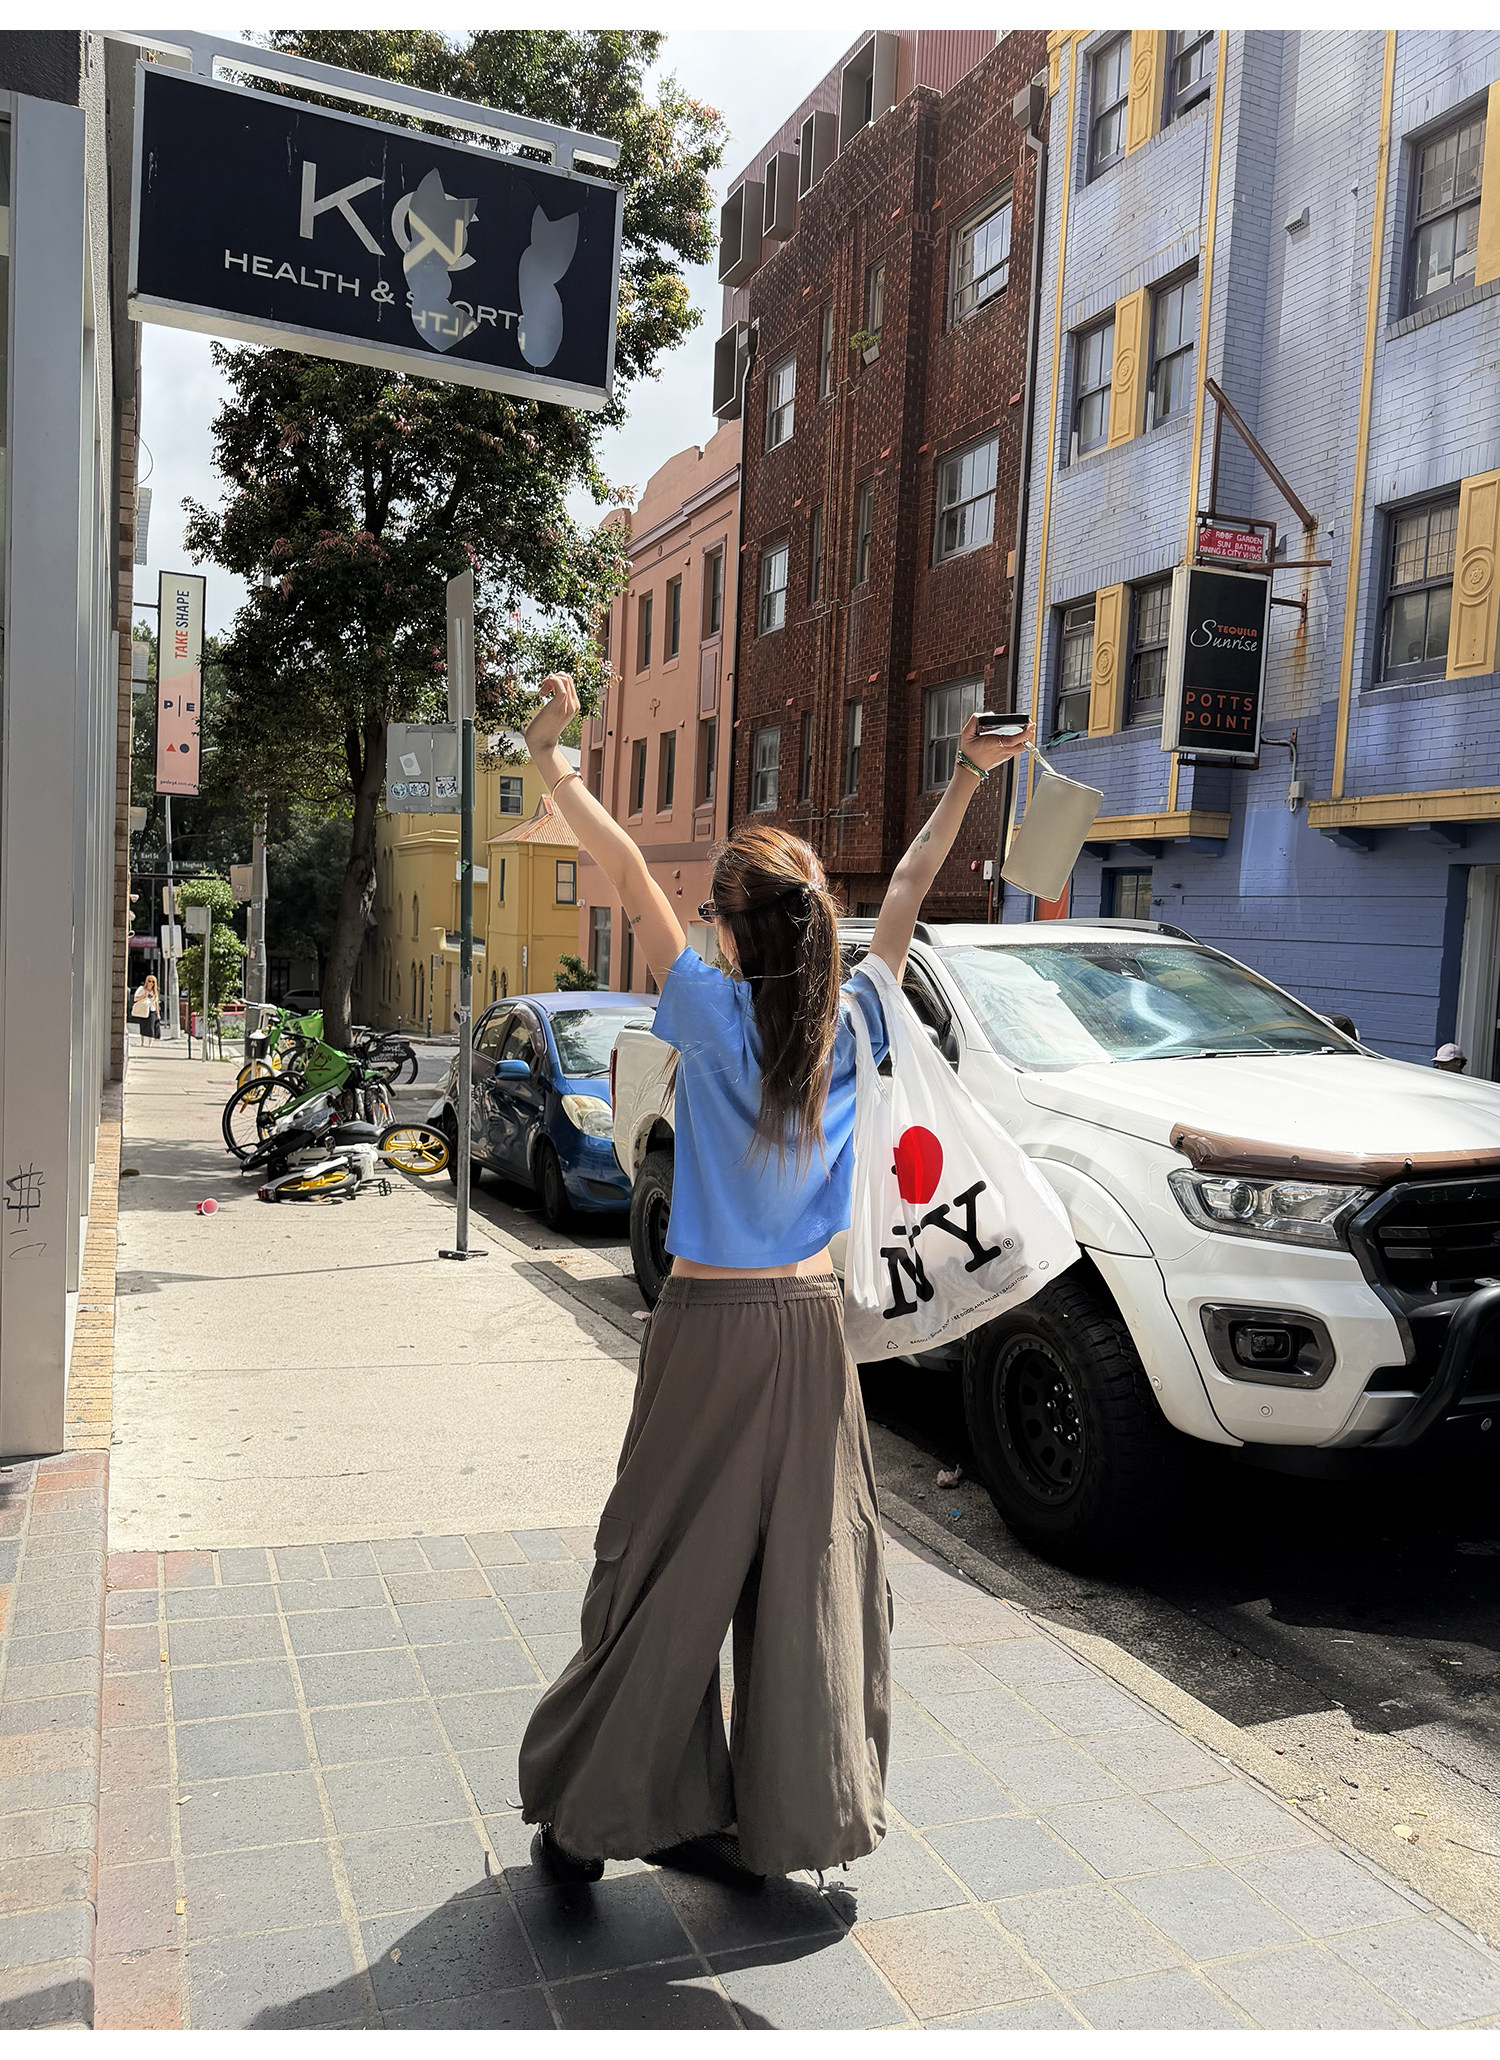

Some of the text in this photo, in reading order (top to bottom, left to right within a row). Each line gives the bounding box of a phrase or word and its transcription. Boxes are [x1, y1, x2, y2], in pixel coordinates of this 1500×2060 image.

[223, 248, 361, 298] HEALTH
[371, 280, 396, 305] &
[1215, 531, 1263, 545] ROOF GARDEN
[1217, 540, 1263, 553] SUN BATHING
[1199, 545, 1221, 555] DINING
[1227, 549, 1242, 558] CITY
[1242, 551, 1262, 561] VIEWS
[174, 589, 190, 660] TAKE SHAPE
[1217, 624, 1258, 637] TEQUILA
[1190, 619, 1259, 652] Sunrise
[1185, 691, 1253, 711] POTTS
[1184, 711, 1252, 730] POINT
[182, 861, 203, 869] Hughes
